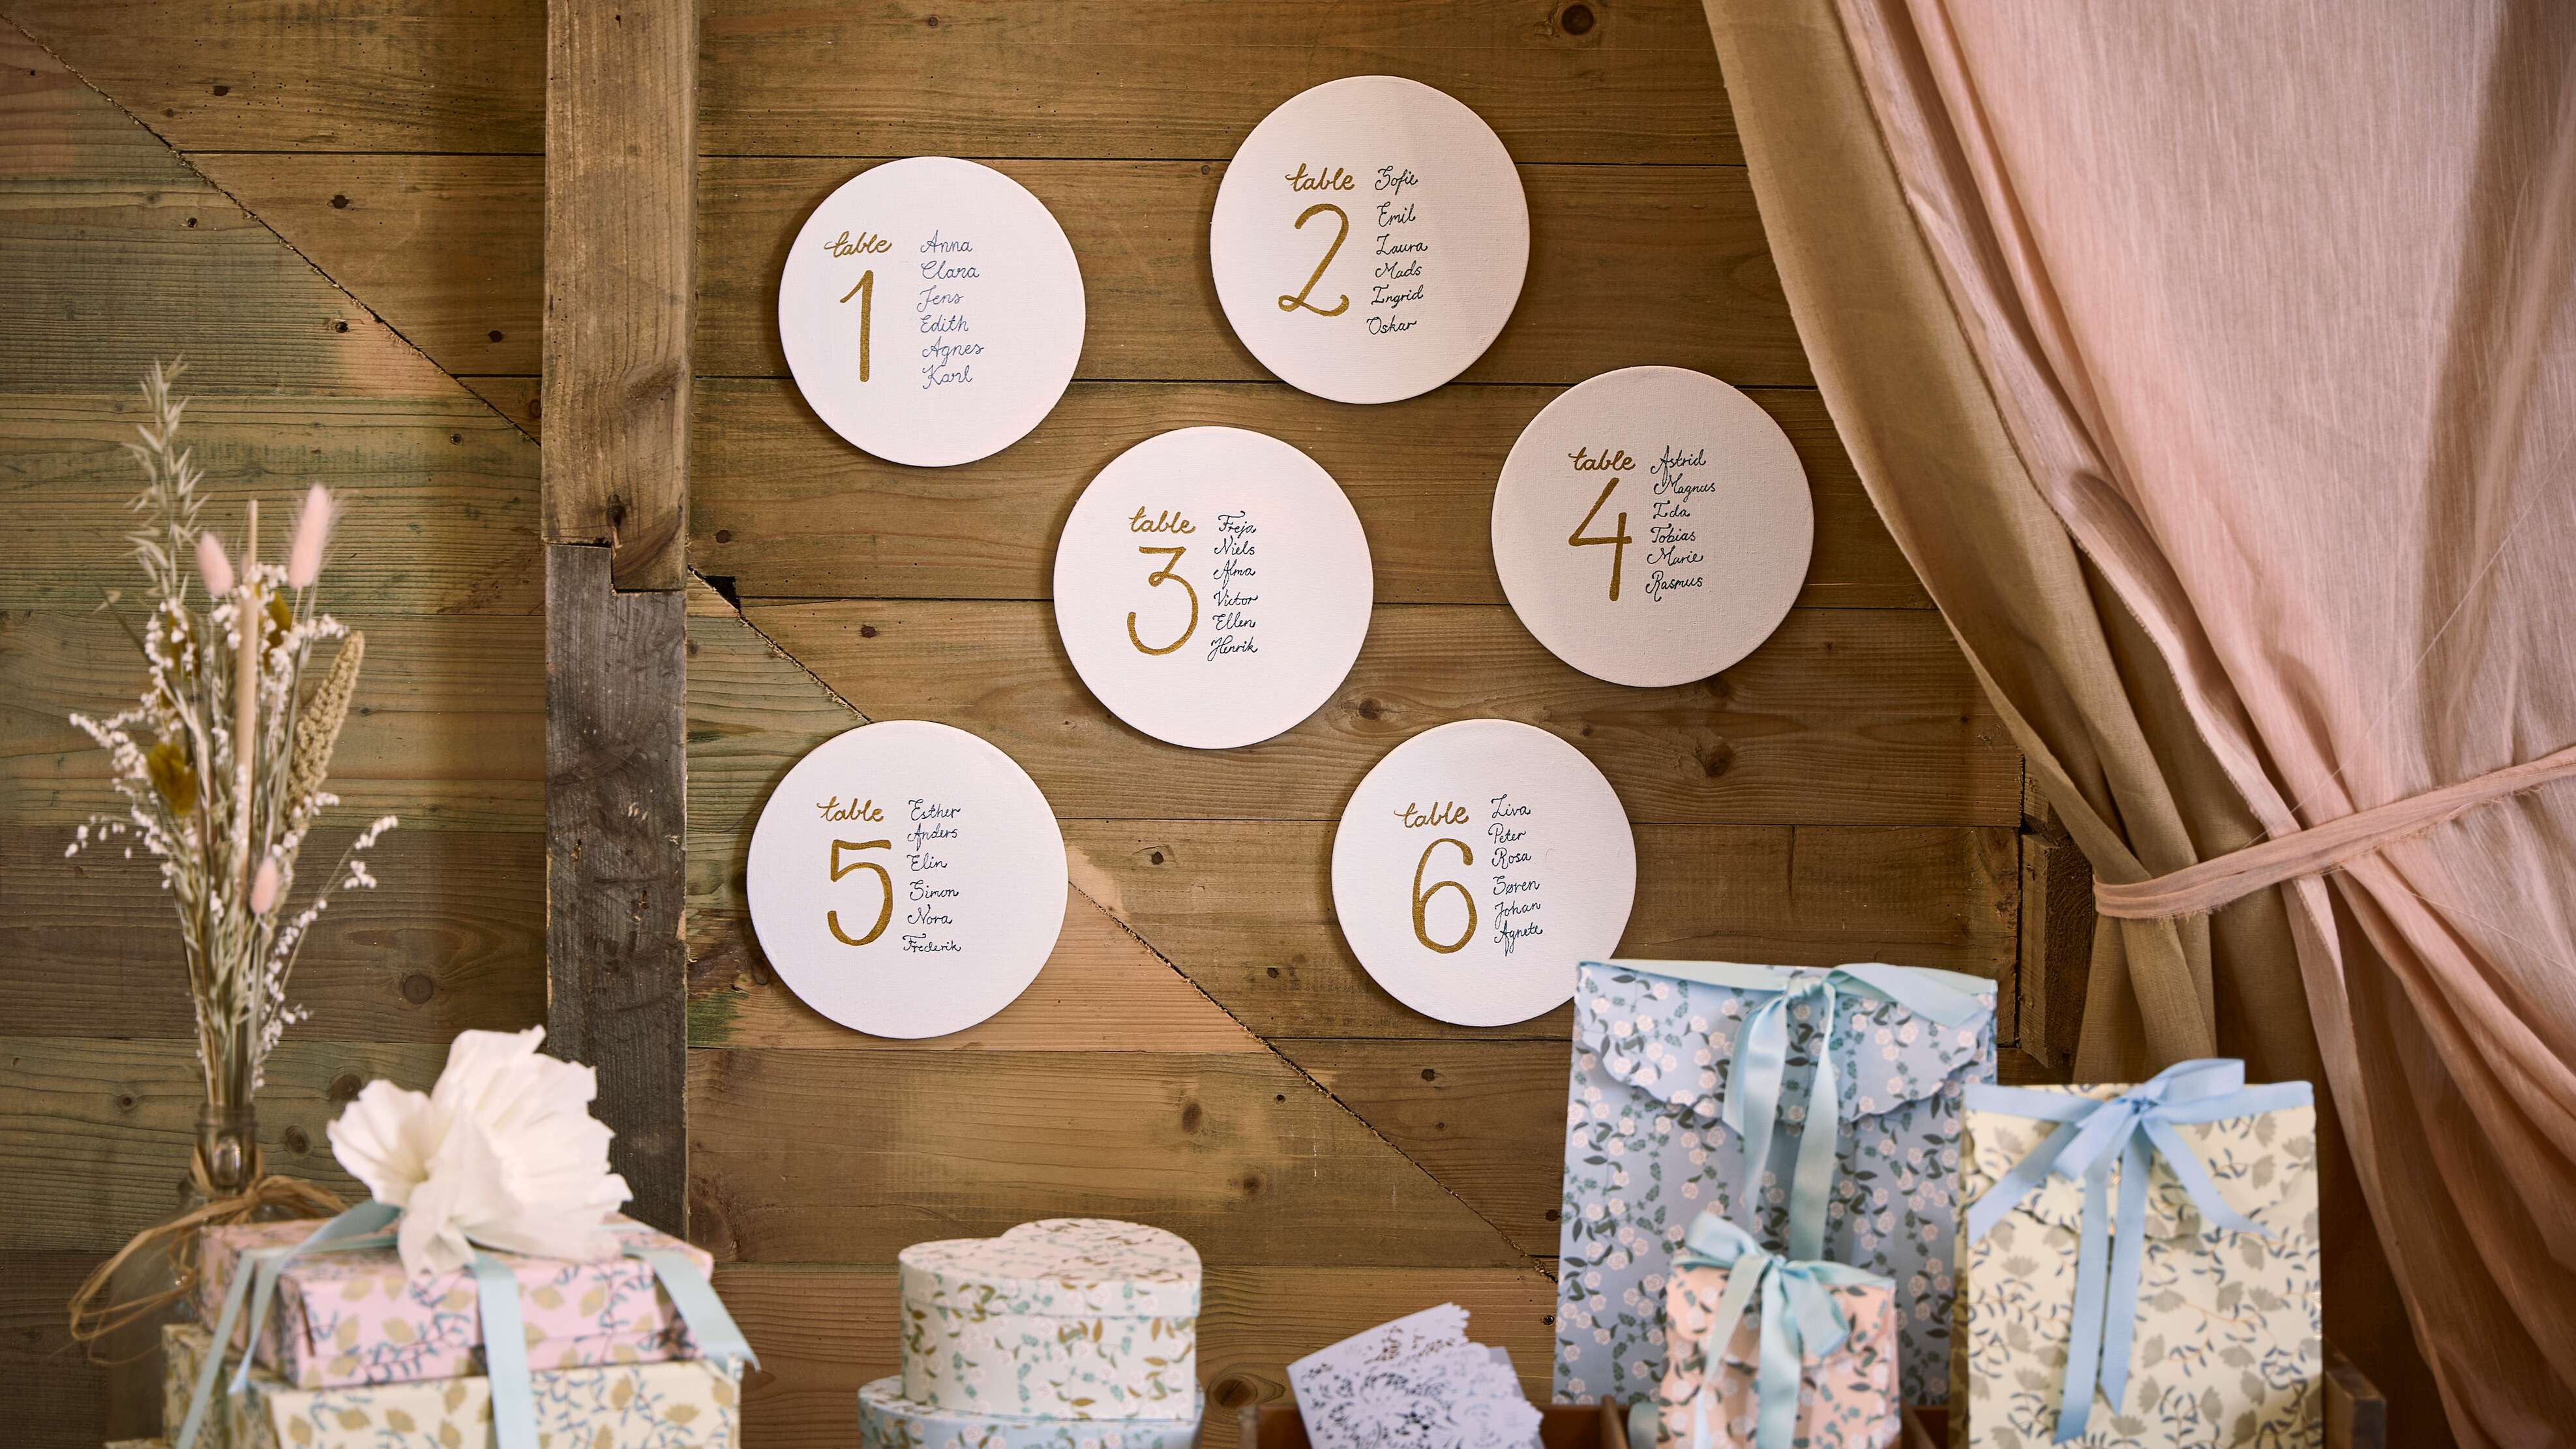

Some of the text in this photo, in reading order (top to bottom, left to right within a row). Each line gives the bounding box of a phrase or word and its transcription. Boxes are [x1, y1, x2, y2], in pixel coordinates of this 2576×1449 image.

[1285, 163, 1355, 192] table
[1375, 166, 1418, 195] Sofie
[1377, 201, 1416, 227] Emil
[824, 231, 892, 258] table
[920, 230, 972, 253] Anna
[1376, 233, 1428, 255] Laura
[921, 261, 980, 279] Clara
[1278, 203, 1349, 316] 2
[1375, 260, 1422, 279] Mads
[917, 285, 963, 312] Jens
[1371, 284, 1424, 308] Ingrid
[840, 270, 873, 382] 1
[920, 314, 968, 333] Edith
[1366, 315, 1417, 335] Oskar
[922, 336, 984, 366] Agnes
[923, 365, 972, 389] Karl
[1568, 447, 1636, 471] table
[1650, 445, 1707, 487] Astrid
[1653, 473, 1716, 502] Magnus
[1128, 505, 1196, 534] table
[1653, 500, 1690, 519] Ida
[1218, 511, 1257, 539] Freja
[1651, 523, 1696, 543] Tobias
[1214, 535, 1255, 556] Niels
[1568, 477, 1632, 602] 4
[1647, 545, 1703, 566] Marie
[1213, 559, 1256, 590] Alma
[1645, 570, 1703, 602] Rasmus
[1127, 546, 1199, 655] 3
[1213, 589, 1259, 606] Victor
[1212, 612, 1256, 631] Ellen
[1207, 635, 1259, 662] Henrik
[816, 796, 884, 822] table
[908, 799, 961, 821] Esther
[1394, 801, 1469, 828] table
[1491, 794, 1531, 818] Liva
[907, 823, 958, 851] Anders
[1488, 823, 1526, 844] Peter
[906, 852, 948, 871] Elin
[1491, 847, 1532, 869] Rosa
[827, 839, 893, 946] 5
[909, 880, 959, 901] Simon
[1412, 838, 1477, 954] 6
[1493, 875, 1540, 895] Søren
[907, 904, 953, 925] Nora
[1495, 901, 1541, 929] Johan
[903, 933, 961, 953] Frederik
[1494, 920, 1543, 957] Agnete
